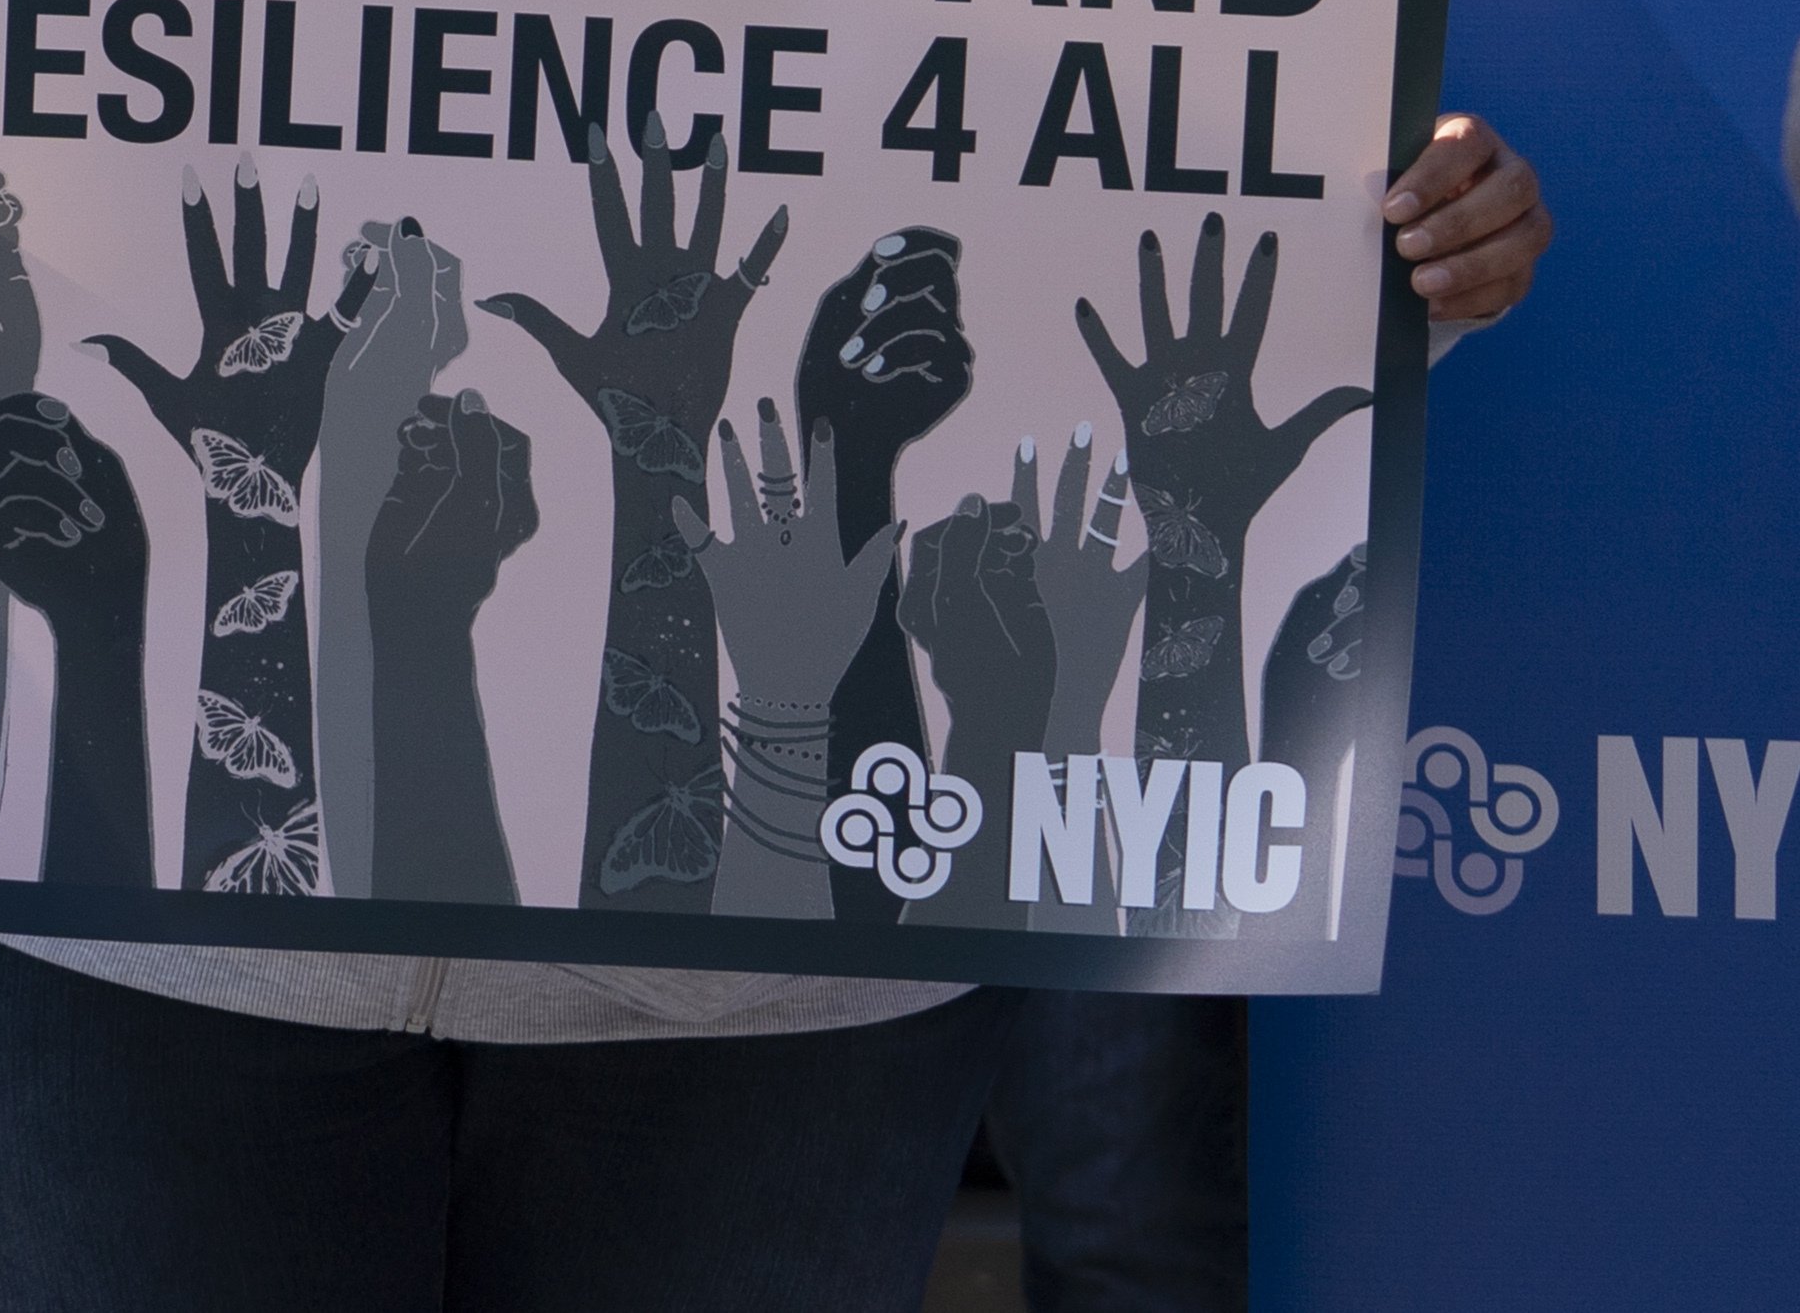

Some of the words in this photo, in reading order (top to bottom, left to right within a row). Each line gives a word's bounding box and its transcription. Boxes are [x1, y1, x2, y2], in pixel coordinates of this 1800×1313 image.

[881, 38, 979, 185] 4
[1020, 41, 1328, 201] ALL
[1006, 751, 1308, 916] NYIC
[1597, 734, 1800, 920] NY
